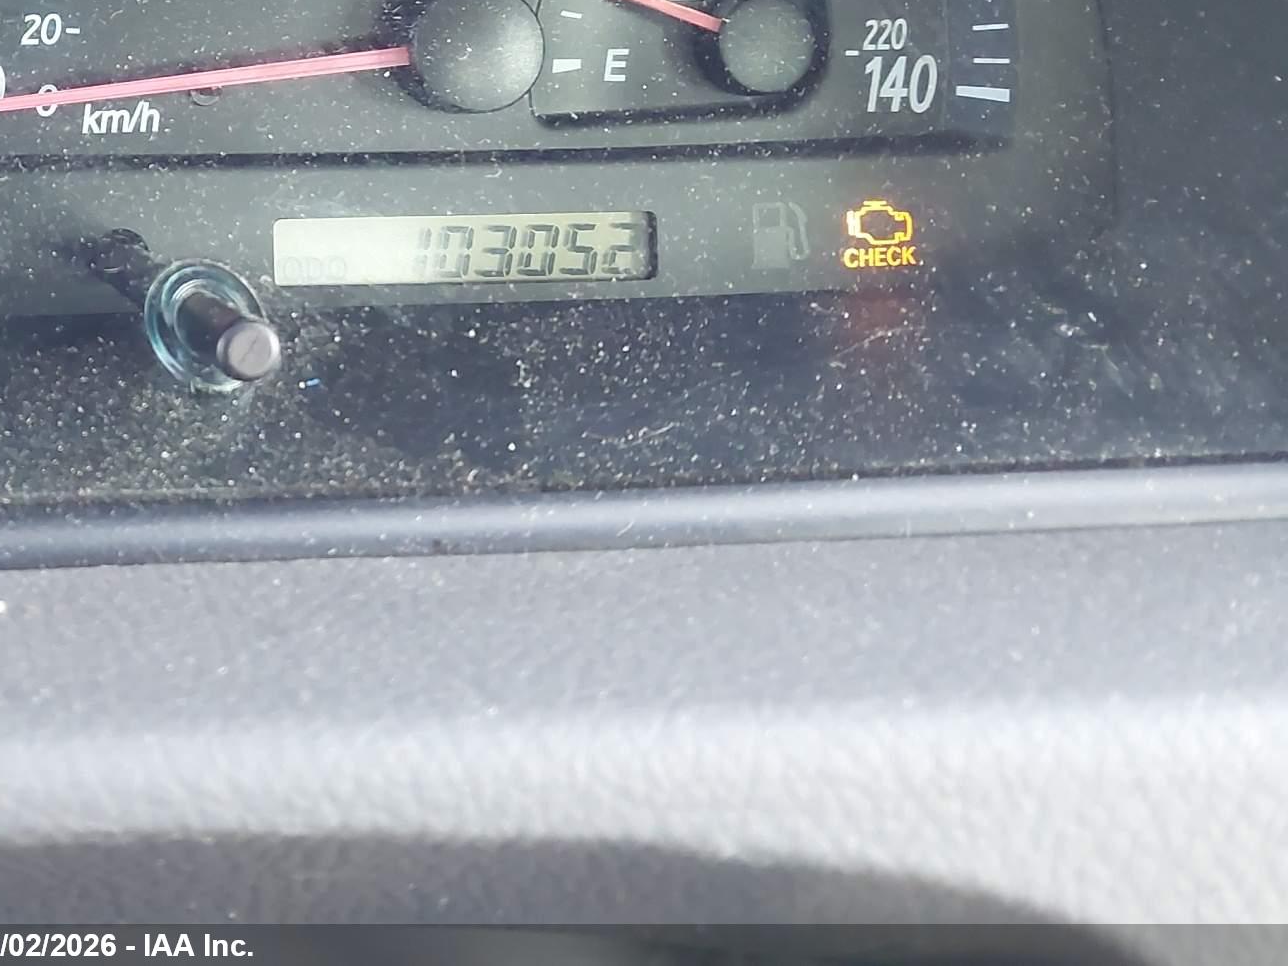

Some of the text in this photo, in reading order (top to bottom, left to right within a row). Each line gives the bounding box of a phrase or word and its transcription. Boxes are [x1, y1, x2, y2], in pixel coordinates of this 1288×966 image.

[20, 14, 61, 45] 20
[862, 19, 908, 51] 220
[604, 49, 630, 82] E
[864, 54, 938, 113] 140
[81, 100, 161, 134] km/h
[414, 223, 637, 279] 103052
[843, 246, 917, 268] CHECK
